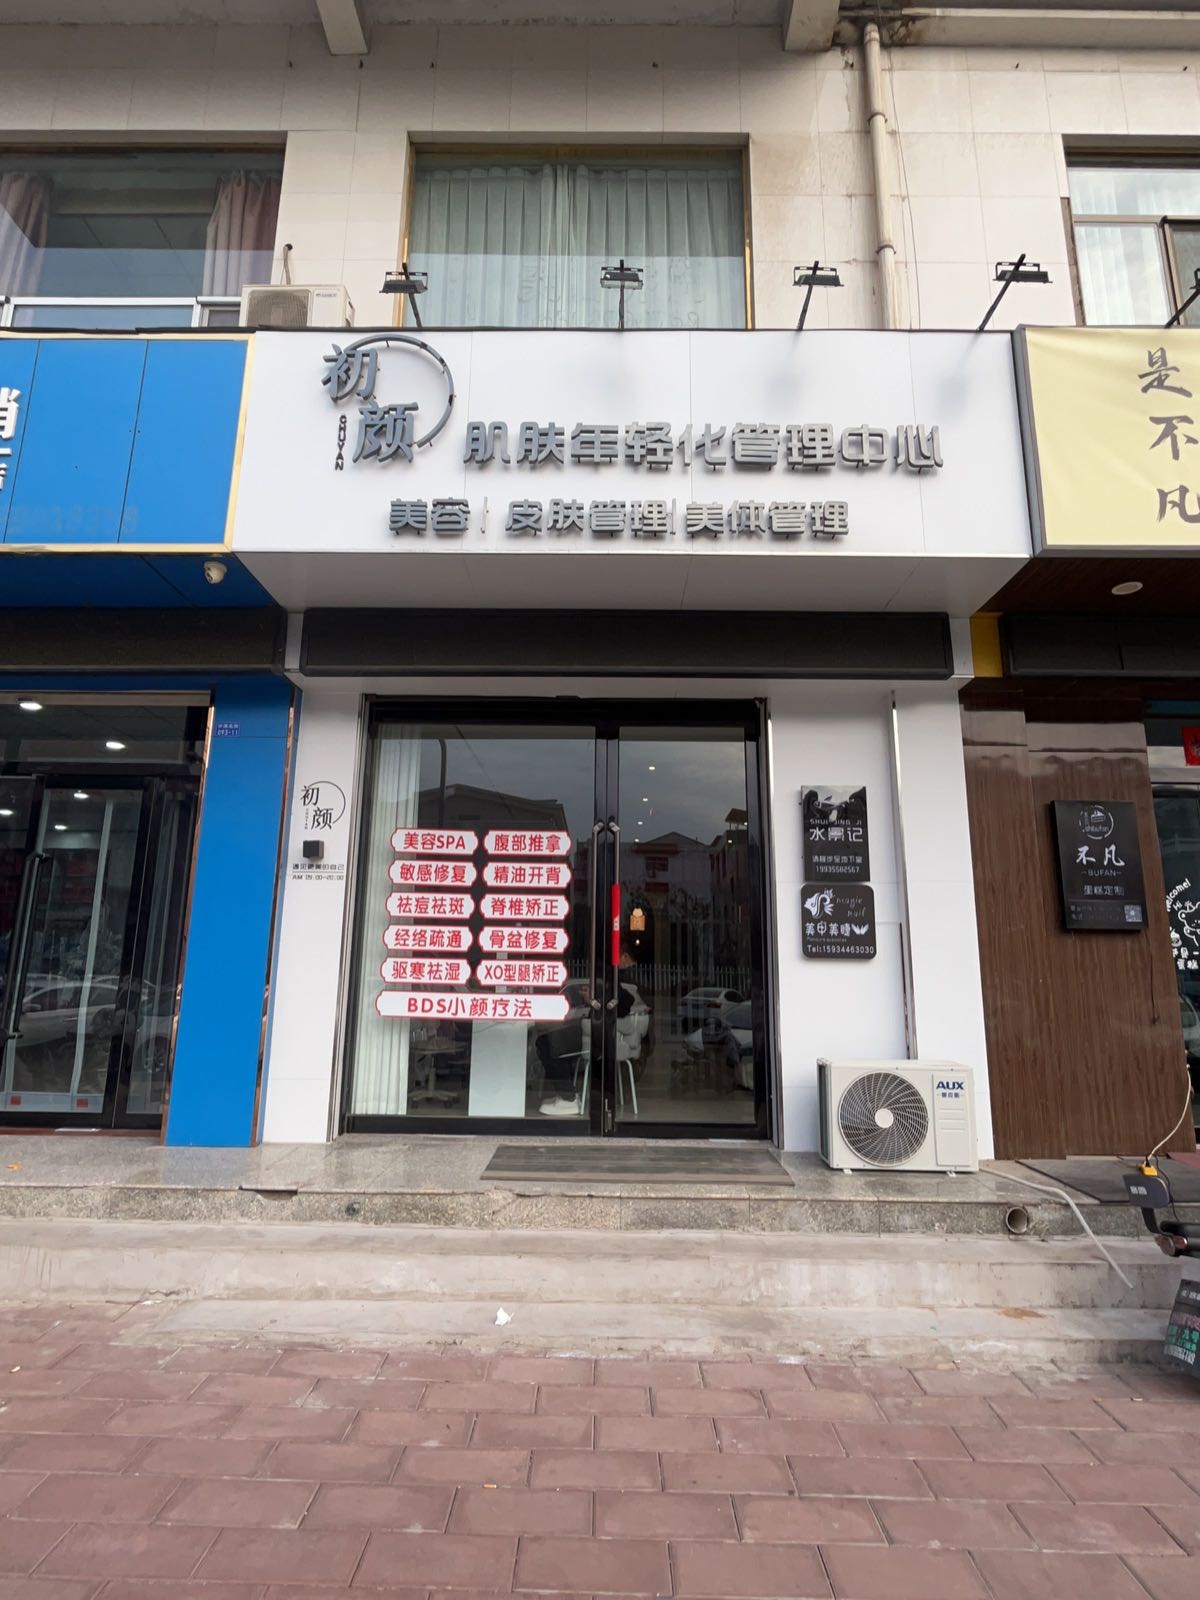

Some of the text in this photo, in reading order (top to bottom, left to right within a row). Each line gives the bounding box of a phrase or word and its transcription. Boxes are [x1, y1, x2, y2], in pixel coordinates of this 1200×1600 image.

[321, 343, 419, 464] 初颜
[335, 414, 347, 471] CHUYAN
[463, 421, 945, 471] 肌肤年轻化管理中心
[388, 496, 850, 539] 美容 皮肤管理 美体管理
[300, 785, 334, 830] 初颜
[404, 832, 465, 850] 美容SPA
[494, 834, 561, 852] 腹部推拿
[1076, 844, 1125, 866] 不凡
[400, 864, 466, 883] 敏感修复
[494, 866, 561, 884] 精油开背
[397, 896, 464, 915] 祛痘祛斑
[491, 898, 558, 916] 脊椎矫正
[394, 929, 462, 948] 经络疏通
[490, 930, 557, 949] 骨盆修复
[392, 961, 460, 981] 驱寒祛湿
[485, 964, 559, 983] XO型腿矫正
[407, 997, 532, 1018] BDS小颜疗法
[936, 1081, 964, 1090] AUX
